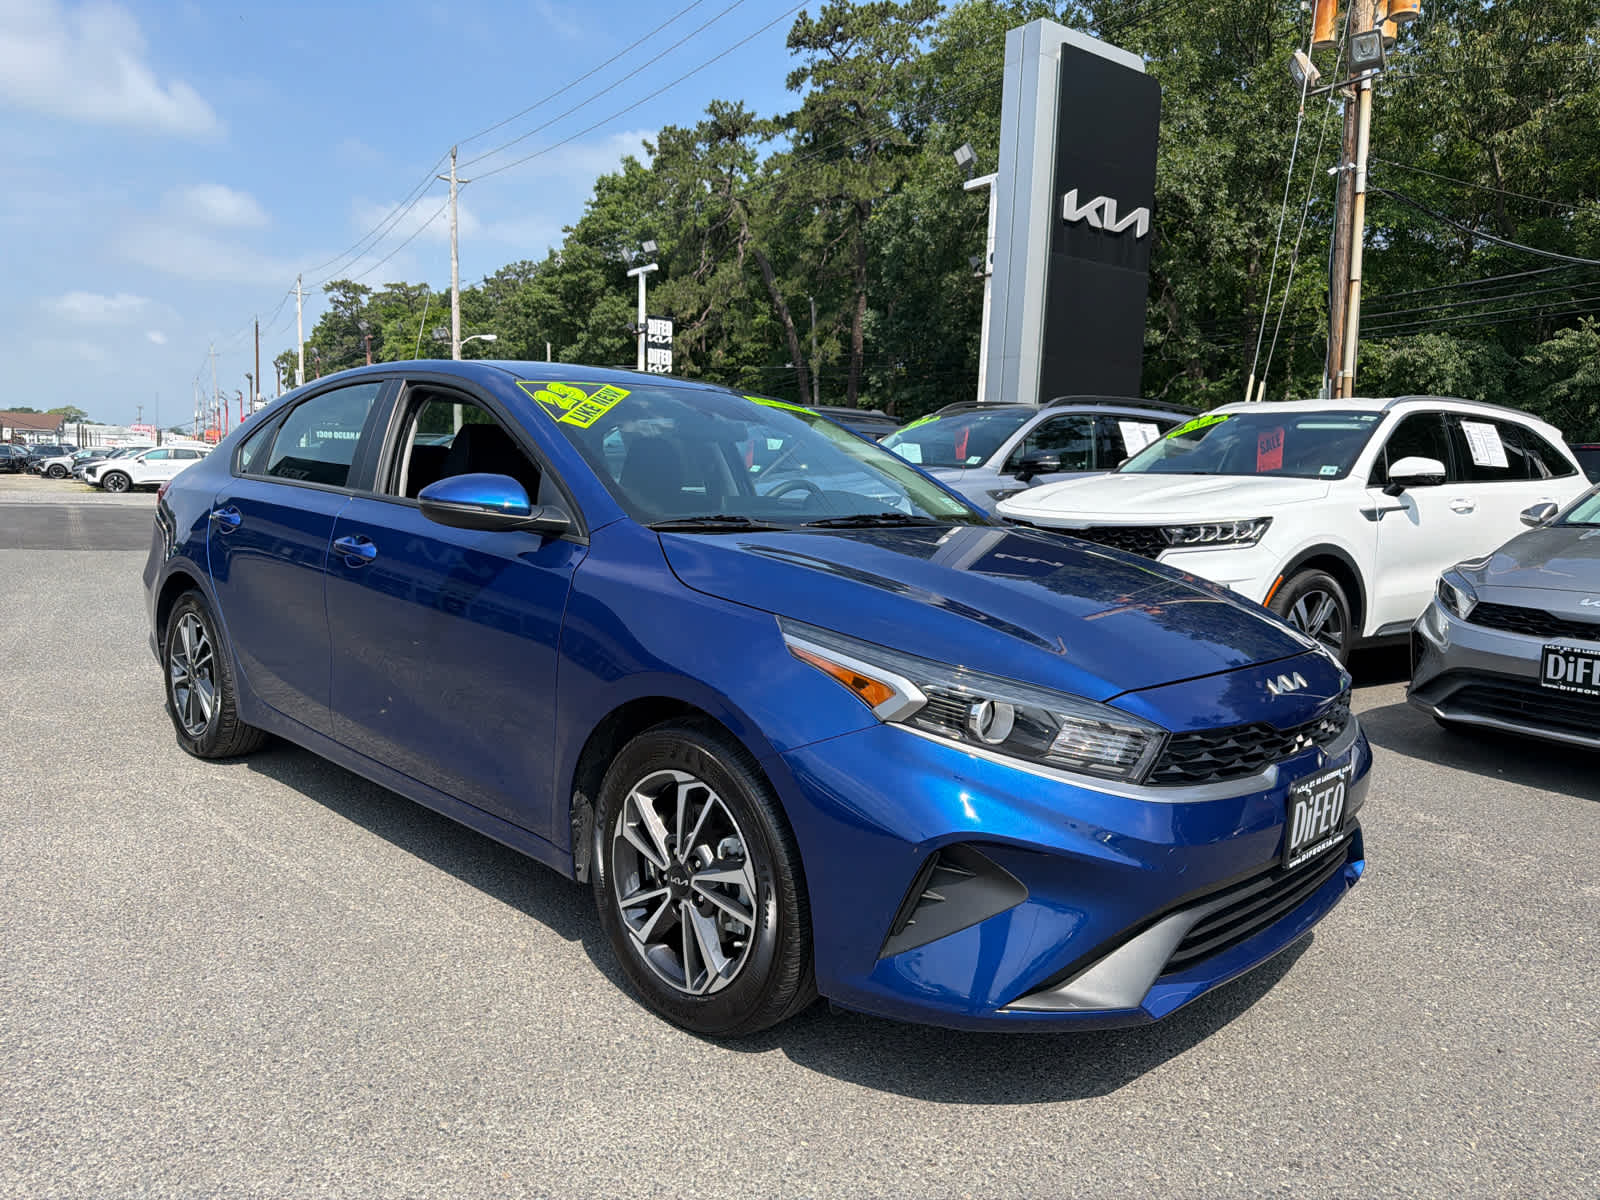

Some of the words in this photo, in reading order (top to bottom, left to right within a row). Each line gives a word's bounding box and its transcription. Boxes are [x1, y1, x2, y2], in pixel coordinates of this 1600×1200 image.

[567, 402, 601, 424] LIKE
[590, 387, 622, 407] NEW
[1260, 432, 1281, 456] SALE
[1290, 781, 1345, 850] DiFEO
